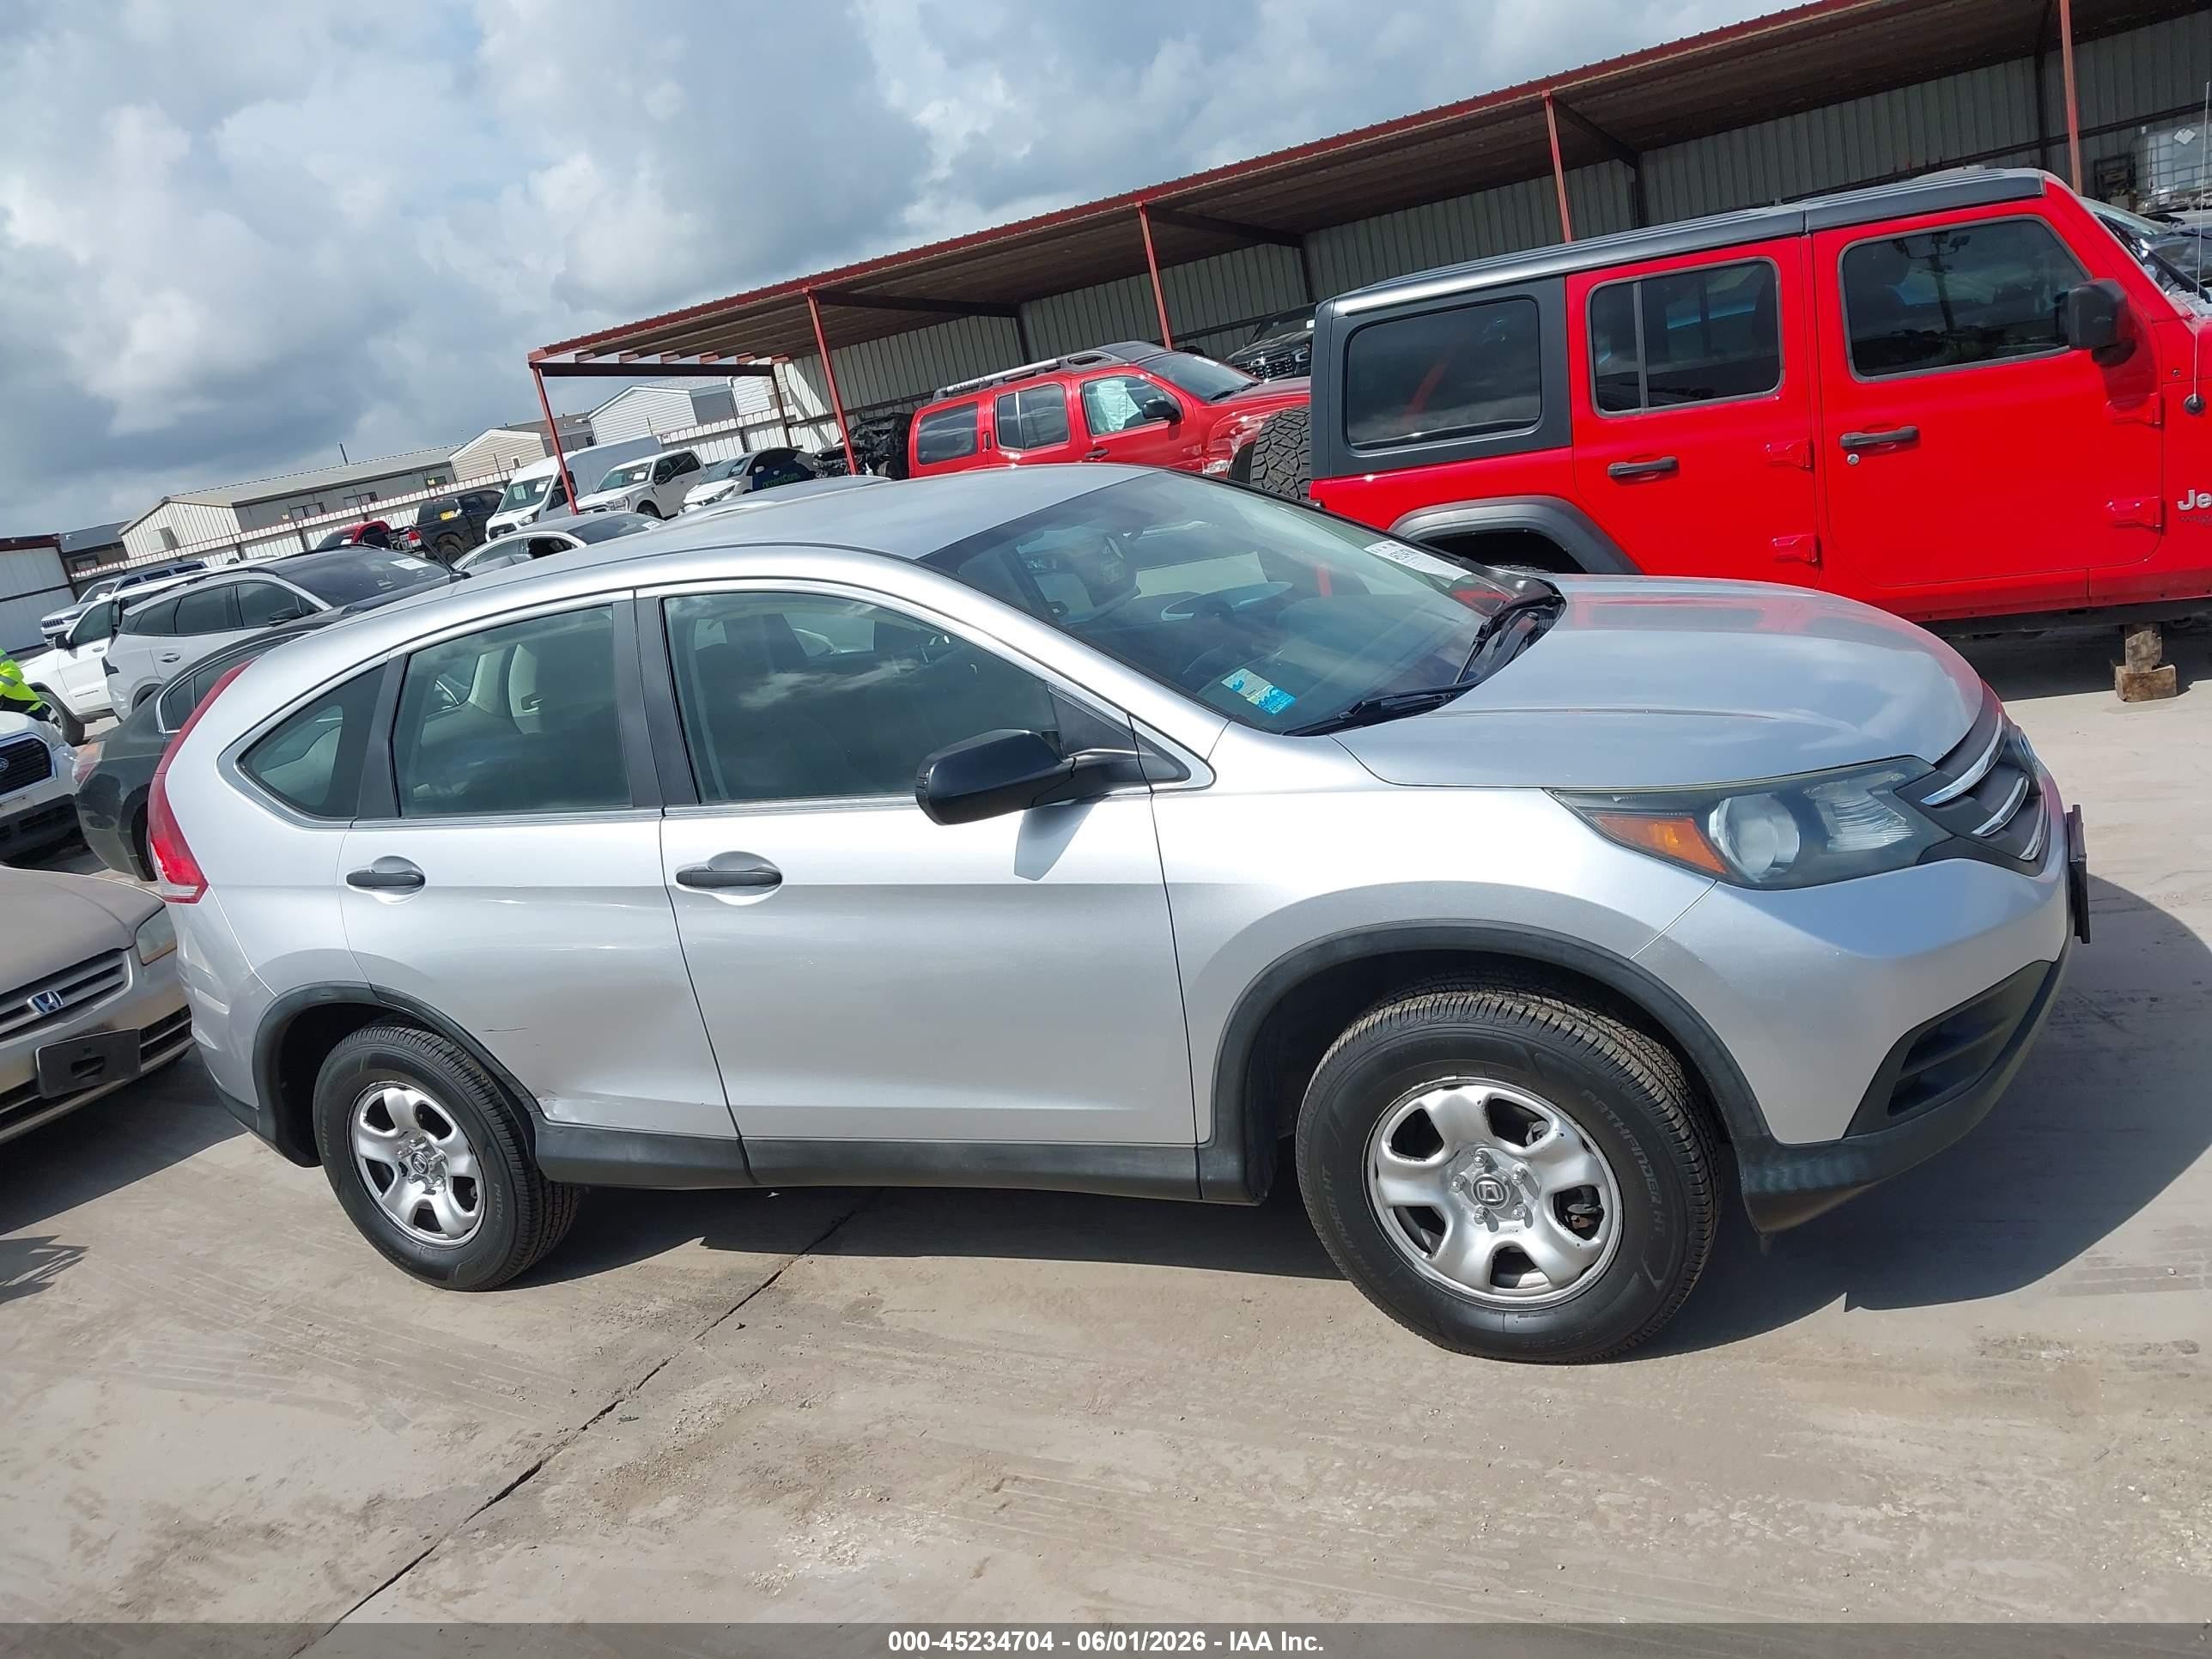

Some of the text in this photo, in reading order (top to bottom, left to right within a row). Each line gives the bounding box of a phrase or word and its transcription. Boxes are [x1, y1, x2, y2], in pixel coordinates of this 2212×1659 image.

[2177, 489, 2212, 511] Je
[1580, 1089, 1668, 1238] PATHFINDER HT
